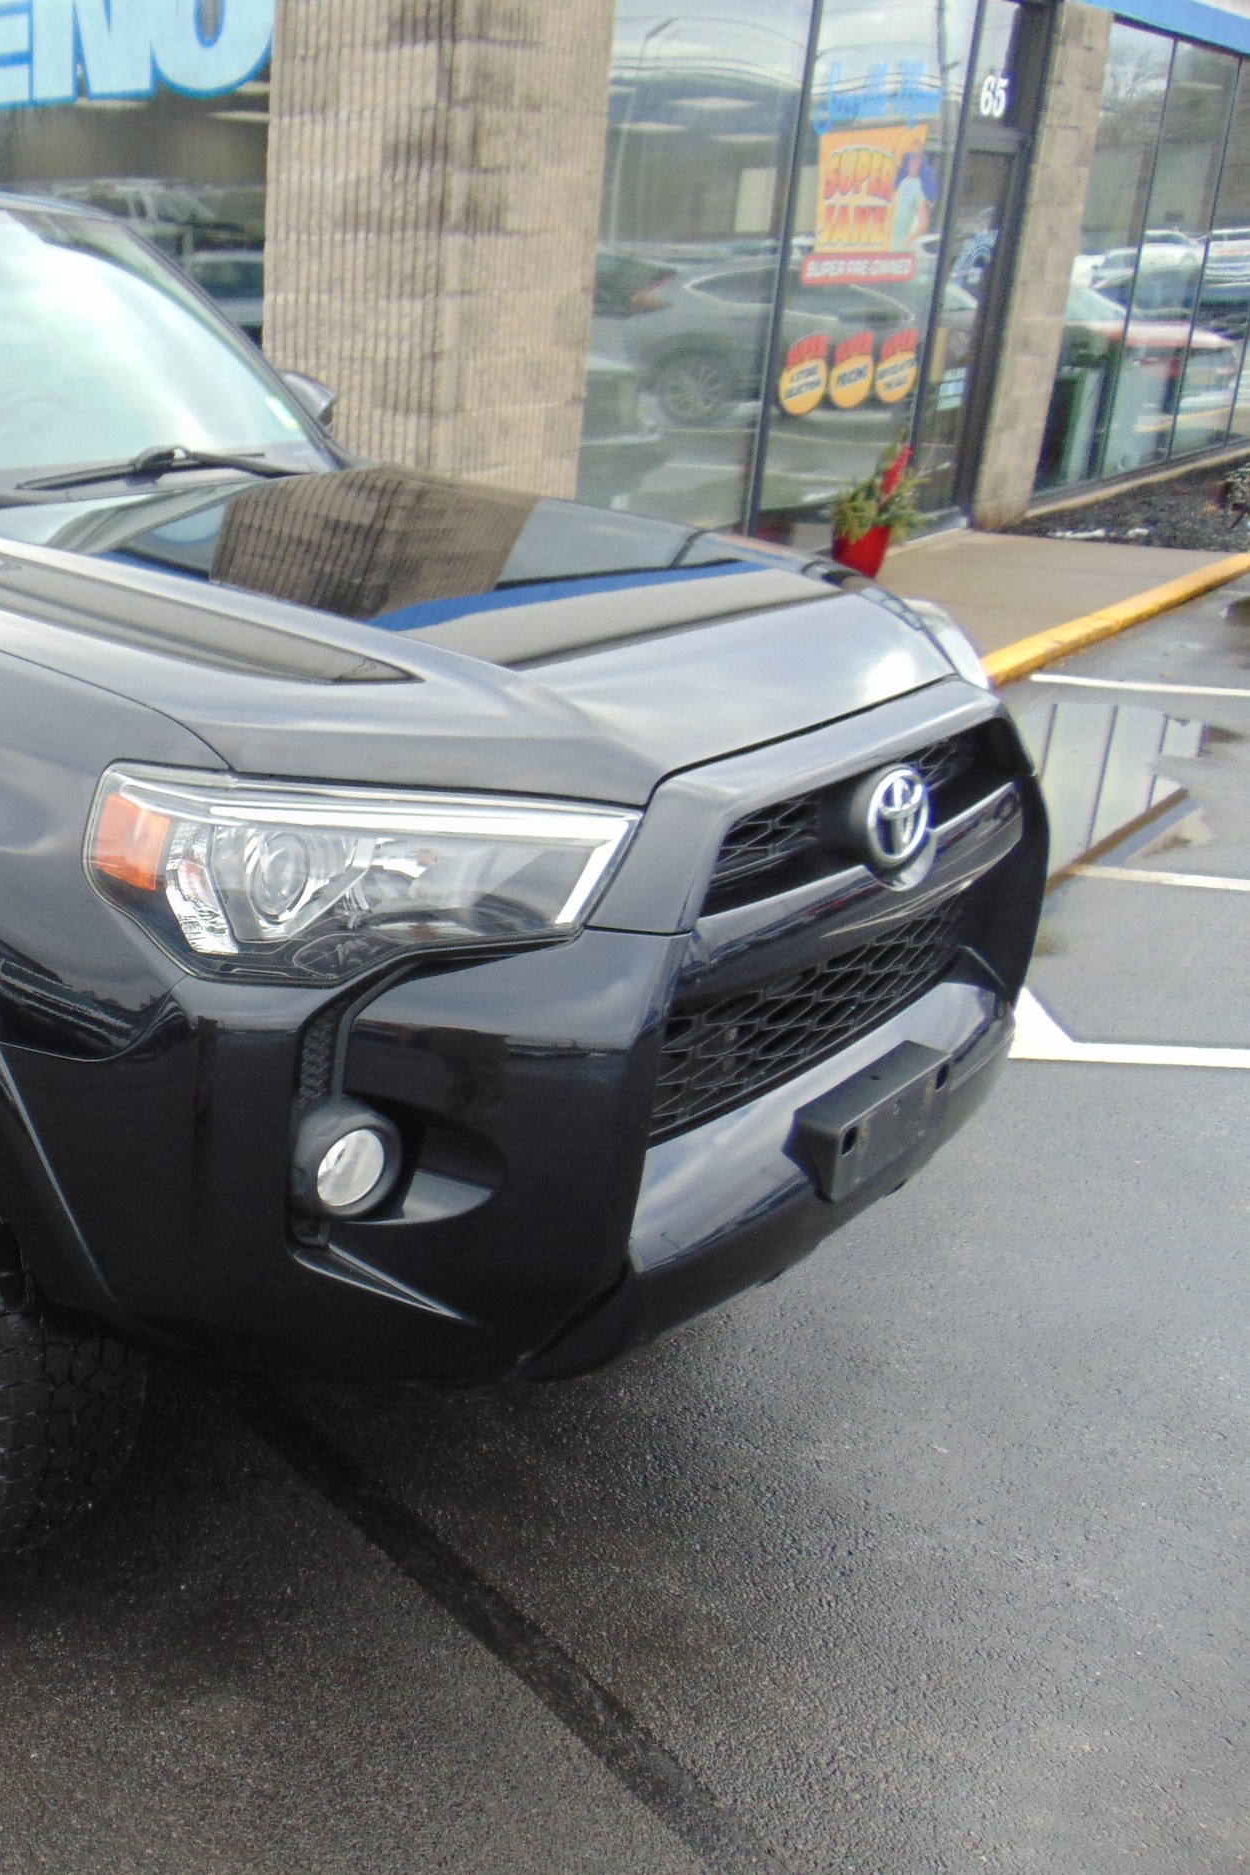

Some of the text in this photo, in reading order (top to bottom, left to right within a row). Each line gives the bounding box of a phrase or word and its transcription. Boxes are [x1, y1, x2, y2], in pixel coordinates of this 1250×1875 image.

[980, 75, 1008, 117] 65
[823, 146, 898, 202] SUPER
[816, 201, 889, 248] JAKE
[806, 260, 846, 278] SUPER
